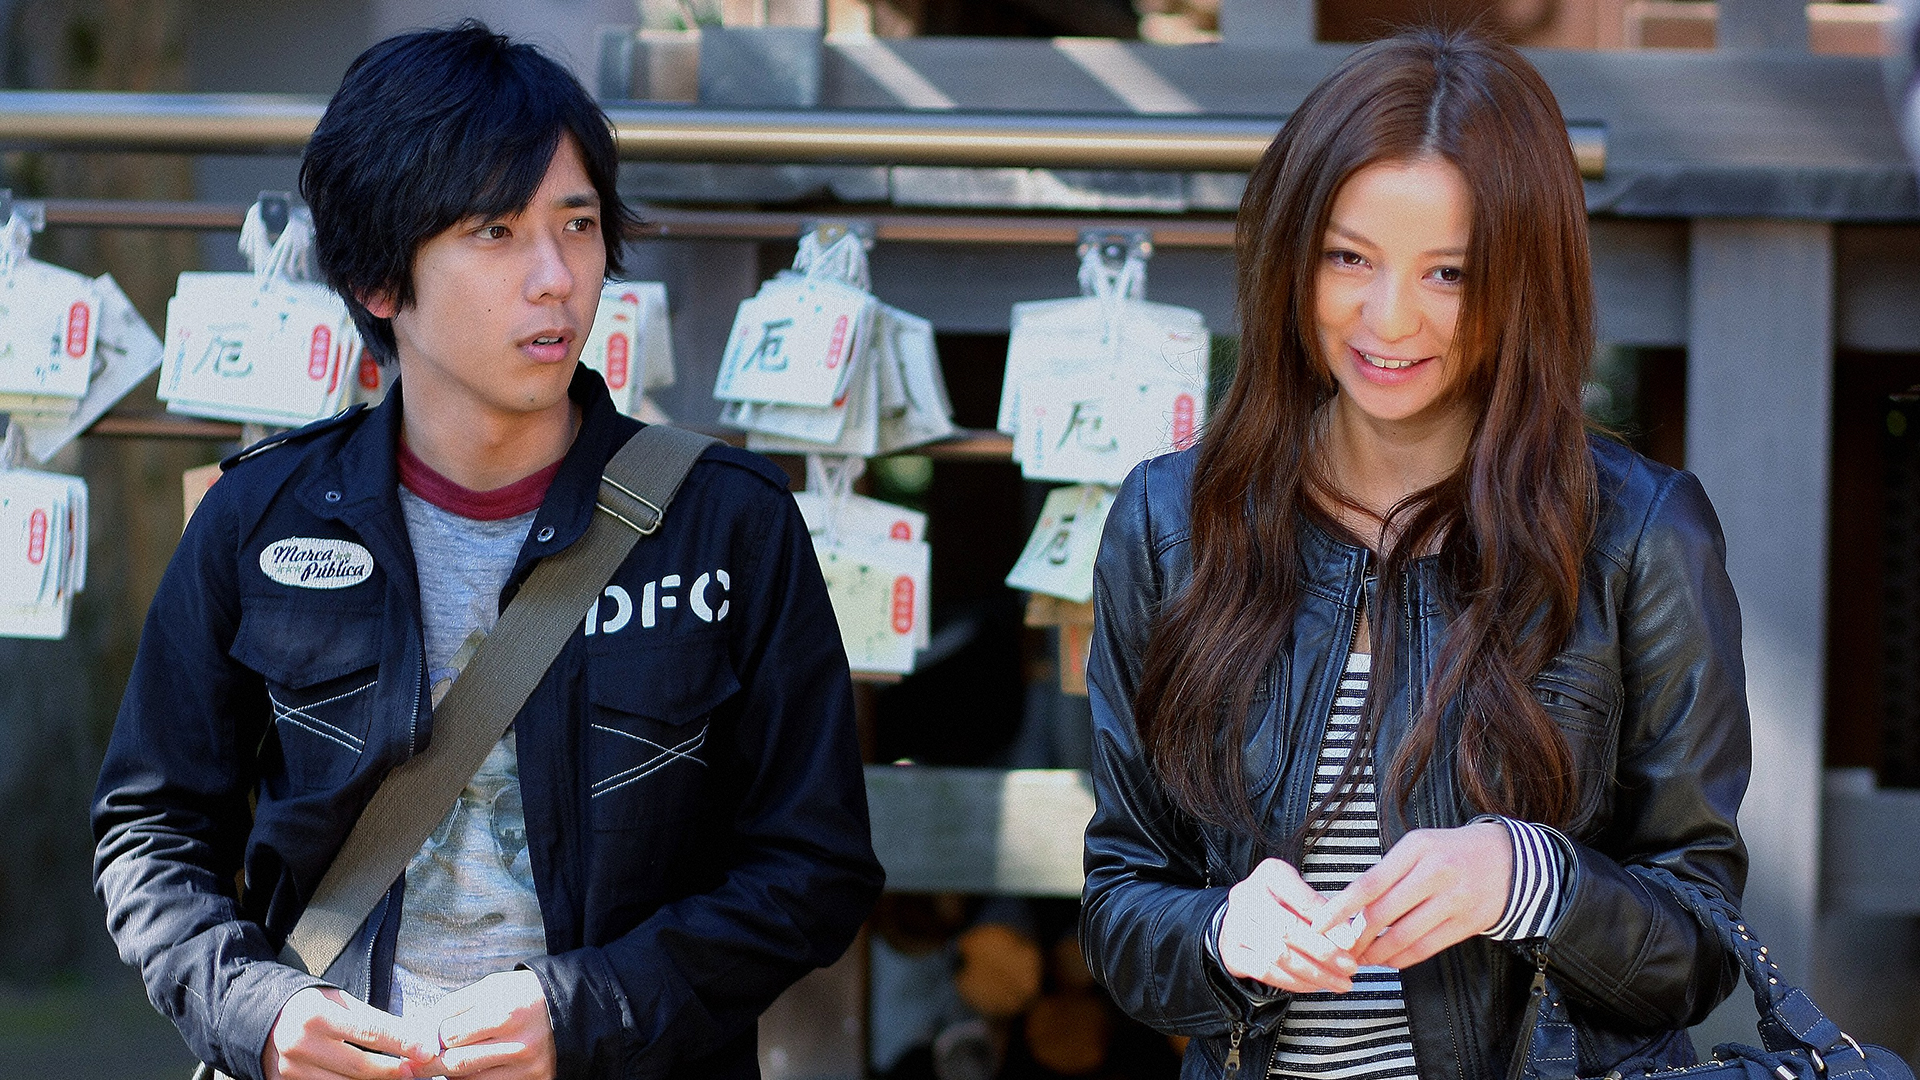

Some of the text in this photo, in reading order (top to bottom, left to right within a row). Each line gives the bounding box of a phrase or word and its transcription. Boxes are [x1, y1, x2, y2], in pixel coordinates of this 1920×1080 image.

[273, 545, 334, 563] Marca
[300, 559, 365, 581] Pública
[584, 568, 730, 636] DFC
